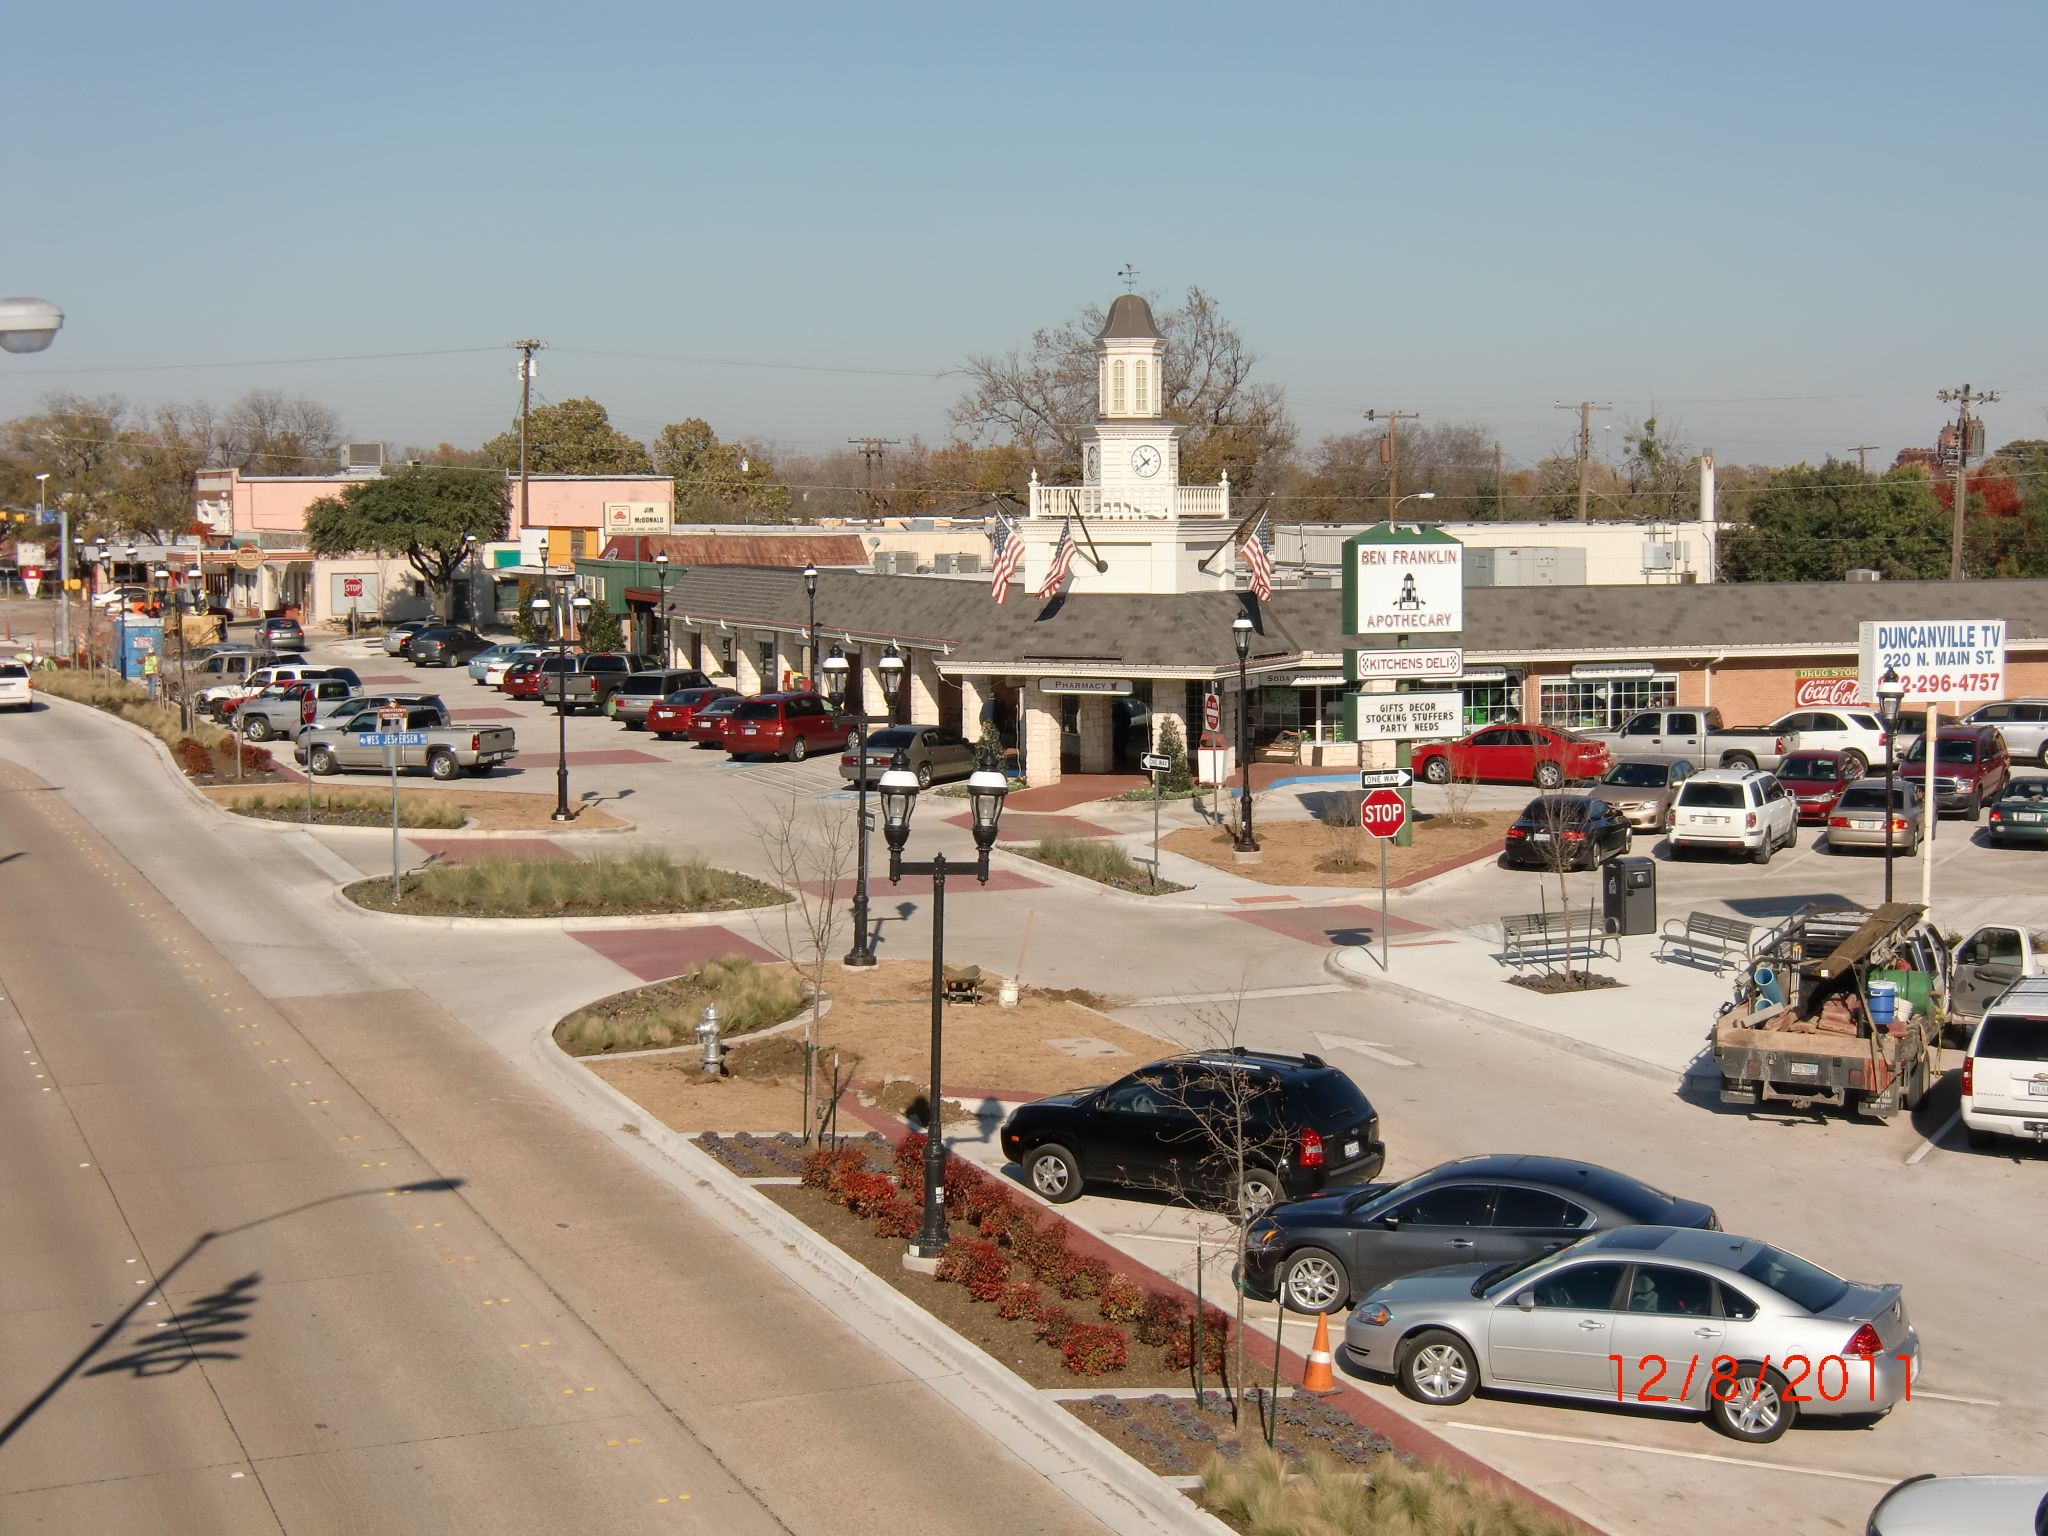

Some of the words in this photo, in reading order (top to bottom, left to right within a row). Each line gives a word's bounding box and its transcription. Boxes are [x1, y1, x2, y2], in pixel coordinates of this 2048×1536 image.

[1361, 551, 1387, 565] BEN
[1393, 550, 1457, 564] FRANKLIN
[1367, 613, 1452, 628] APOTHECARY
[1878, 626, 1975, 649] DUNCANVILLE
[1981, 625, 2000, 647] TV
[1370, 658, 1423, 670] KITCHENS
[1426, 657, 1450, 669] DELI
[1884, 653, 1911, 668] 220
[1917, 652, 1929, 666] N.
[1935, 651, 1970, 665] MAIN
[1976, 650, 1995, 664] ST.
[1267, 674, 1290, 682] SODA
[1878, 673, 1999, 693] 2-296-4757
[1055, 681, 1106, 689] PHARMACY
[1797, 679, 1861, 706] Coca-Col
[304, 701, 317, 714] STOP
[1380, 703, 1404, 713] GIFTS
[1409, 703, 1436, 711] DECOR
[1366, 713, 1407, 723] STOCKING
[1412, 711, 1454, 721] STUFFERS
[1380, 724, 1408, 733] PARTY
[1415, 722, 1439, 731] NEEDS
[367, 735, 380, 744] WES
[1365, 804, 1402, 823] STOP
